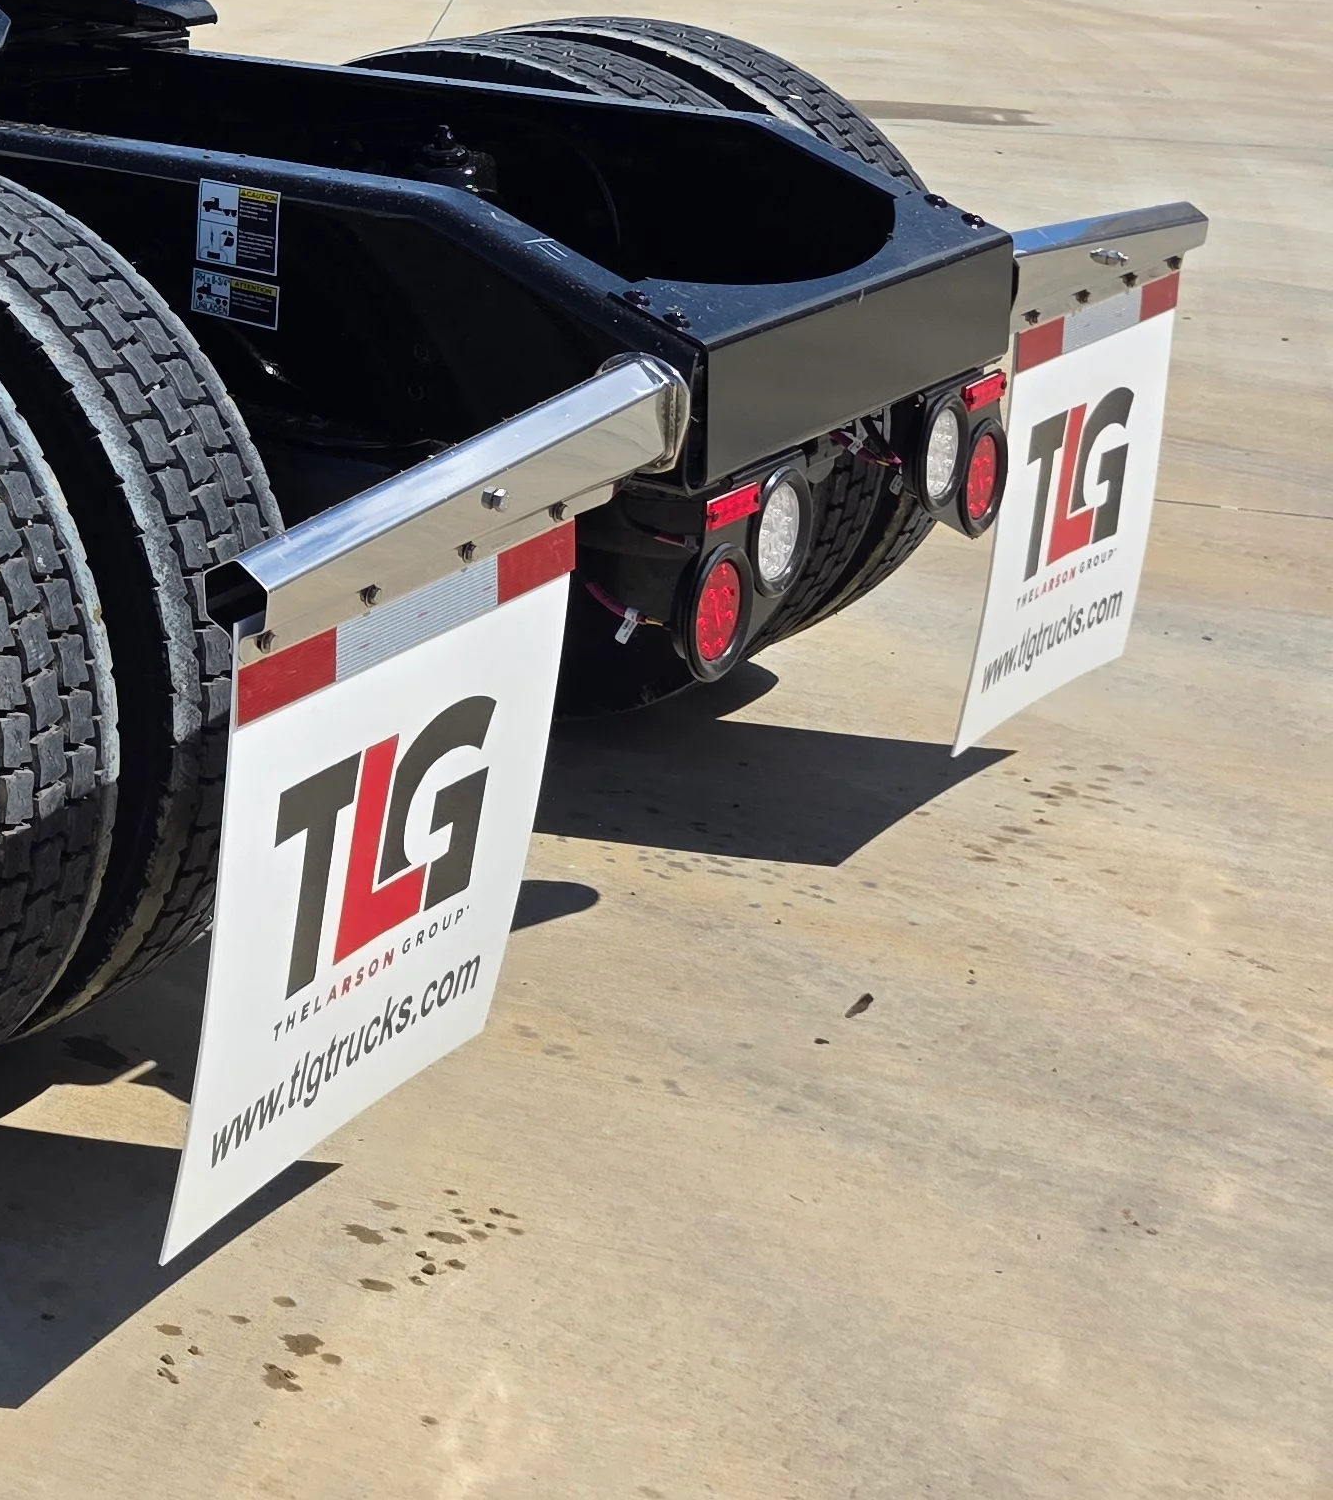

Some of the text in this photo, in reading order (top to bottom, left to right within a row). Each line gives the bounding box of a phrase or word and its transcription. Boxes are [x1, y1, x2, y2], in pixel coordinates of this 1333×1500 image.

[247, 191, 276, 201] CAUTION
[196, 299, 228, 314] UNLADEN
[234, 281, 273, 295] ATTENTION
[1023, 386, 1135, 583] TLG
[1079, 550, 1113, 574] GROUP
[980, 590, 1123, 694] www.tlgtrucks.com
[274, 695, 498, 1000] TLG
[401, 911, 465, 955] GROUP
[210, 954, 481, 1169] www.tlgtrucks.com
